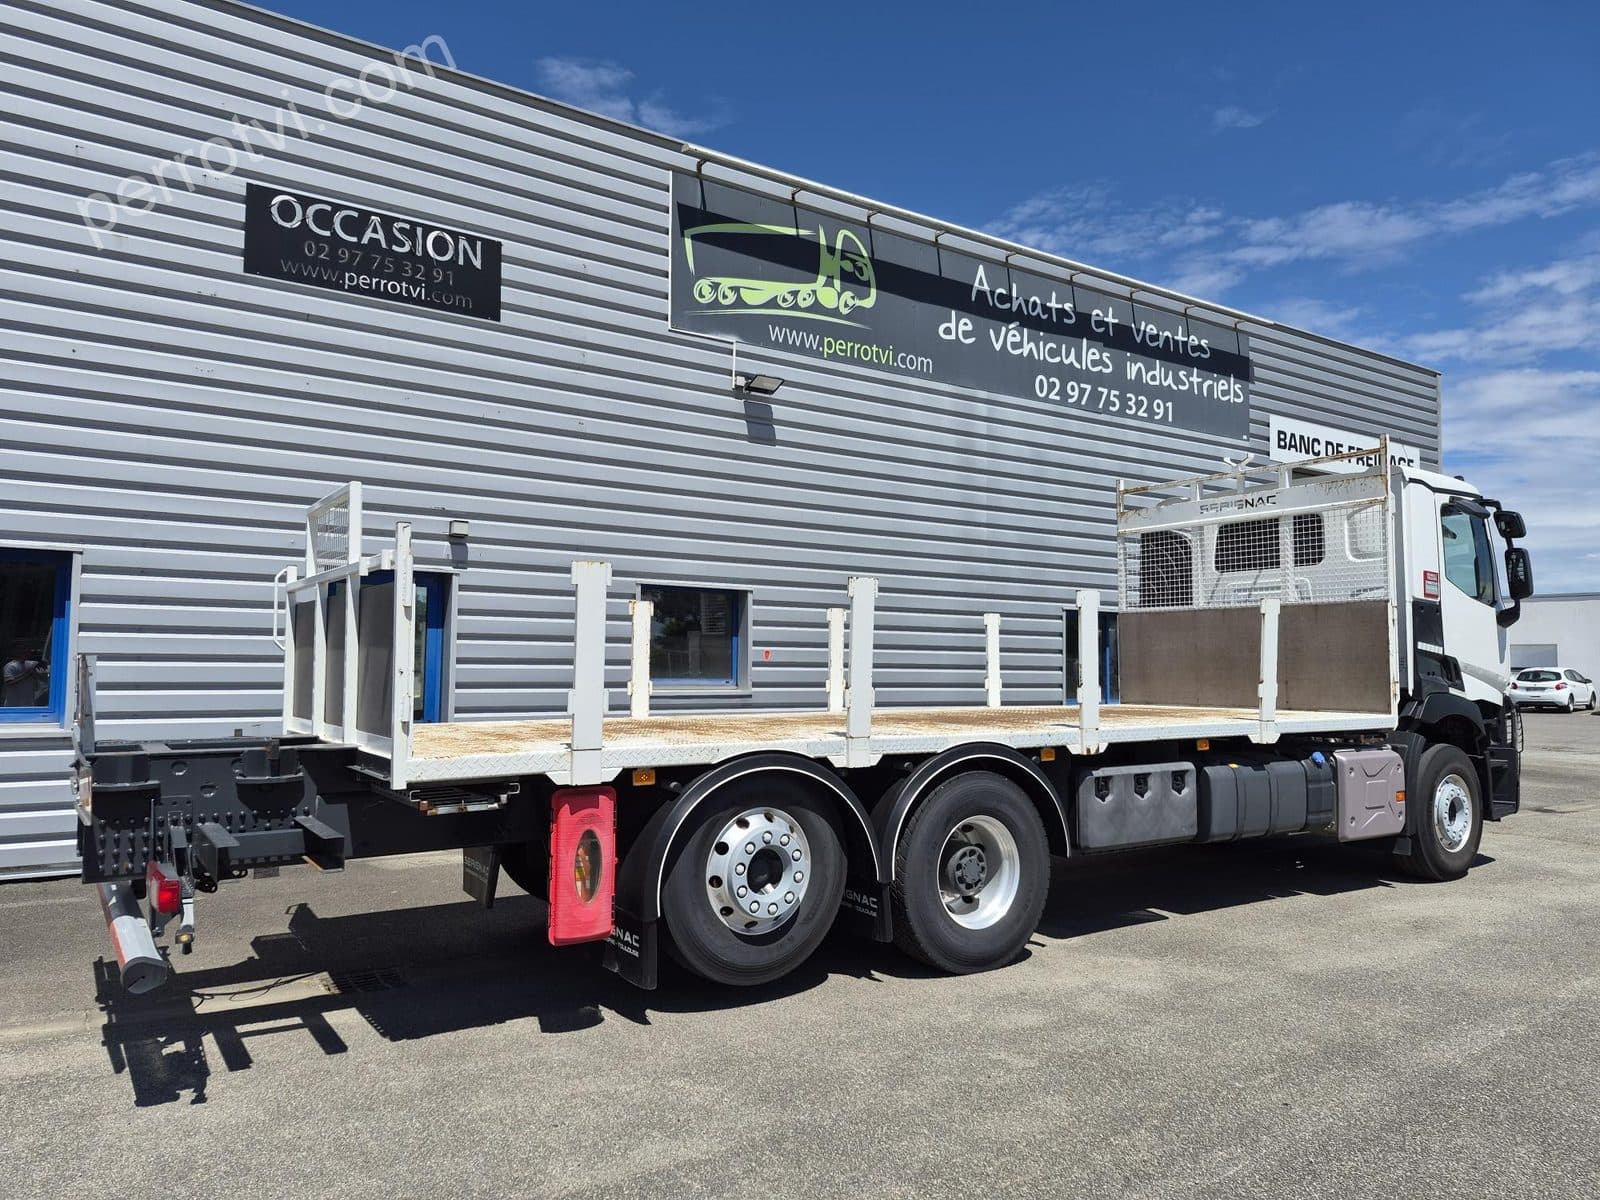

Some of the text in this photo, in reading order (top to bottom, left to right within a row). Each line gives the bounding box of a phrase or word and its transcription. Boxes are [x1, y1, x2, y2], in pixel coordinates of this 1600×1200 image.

[270, 194, 482, 270] OCCASION
[280, 258, 473, 310] www.perrotvi.com
[304, 240, 454, 285] 02 97 75 32 91
[971, 264, 1211, 359] Achats et ventes
[768, 324, 933, 373] www.perrotvi.com
[938, 310, 1244, 403] de véhicules industriels
[1035, 375, 1172, 422] 02 97 75 32 91
[1277, 430, 1321, 457] BANC
[1347, 445, 1414, 469] FREIAGE
